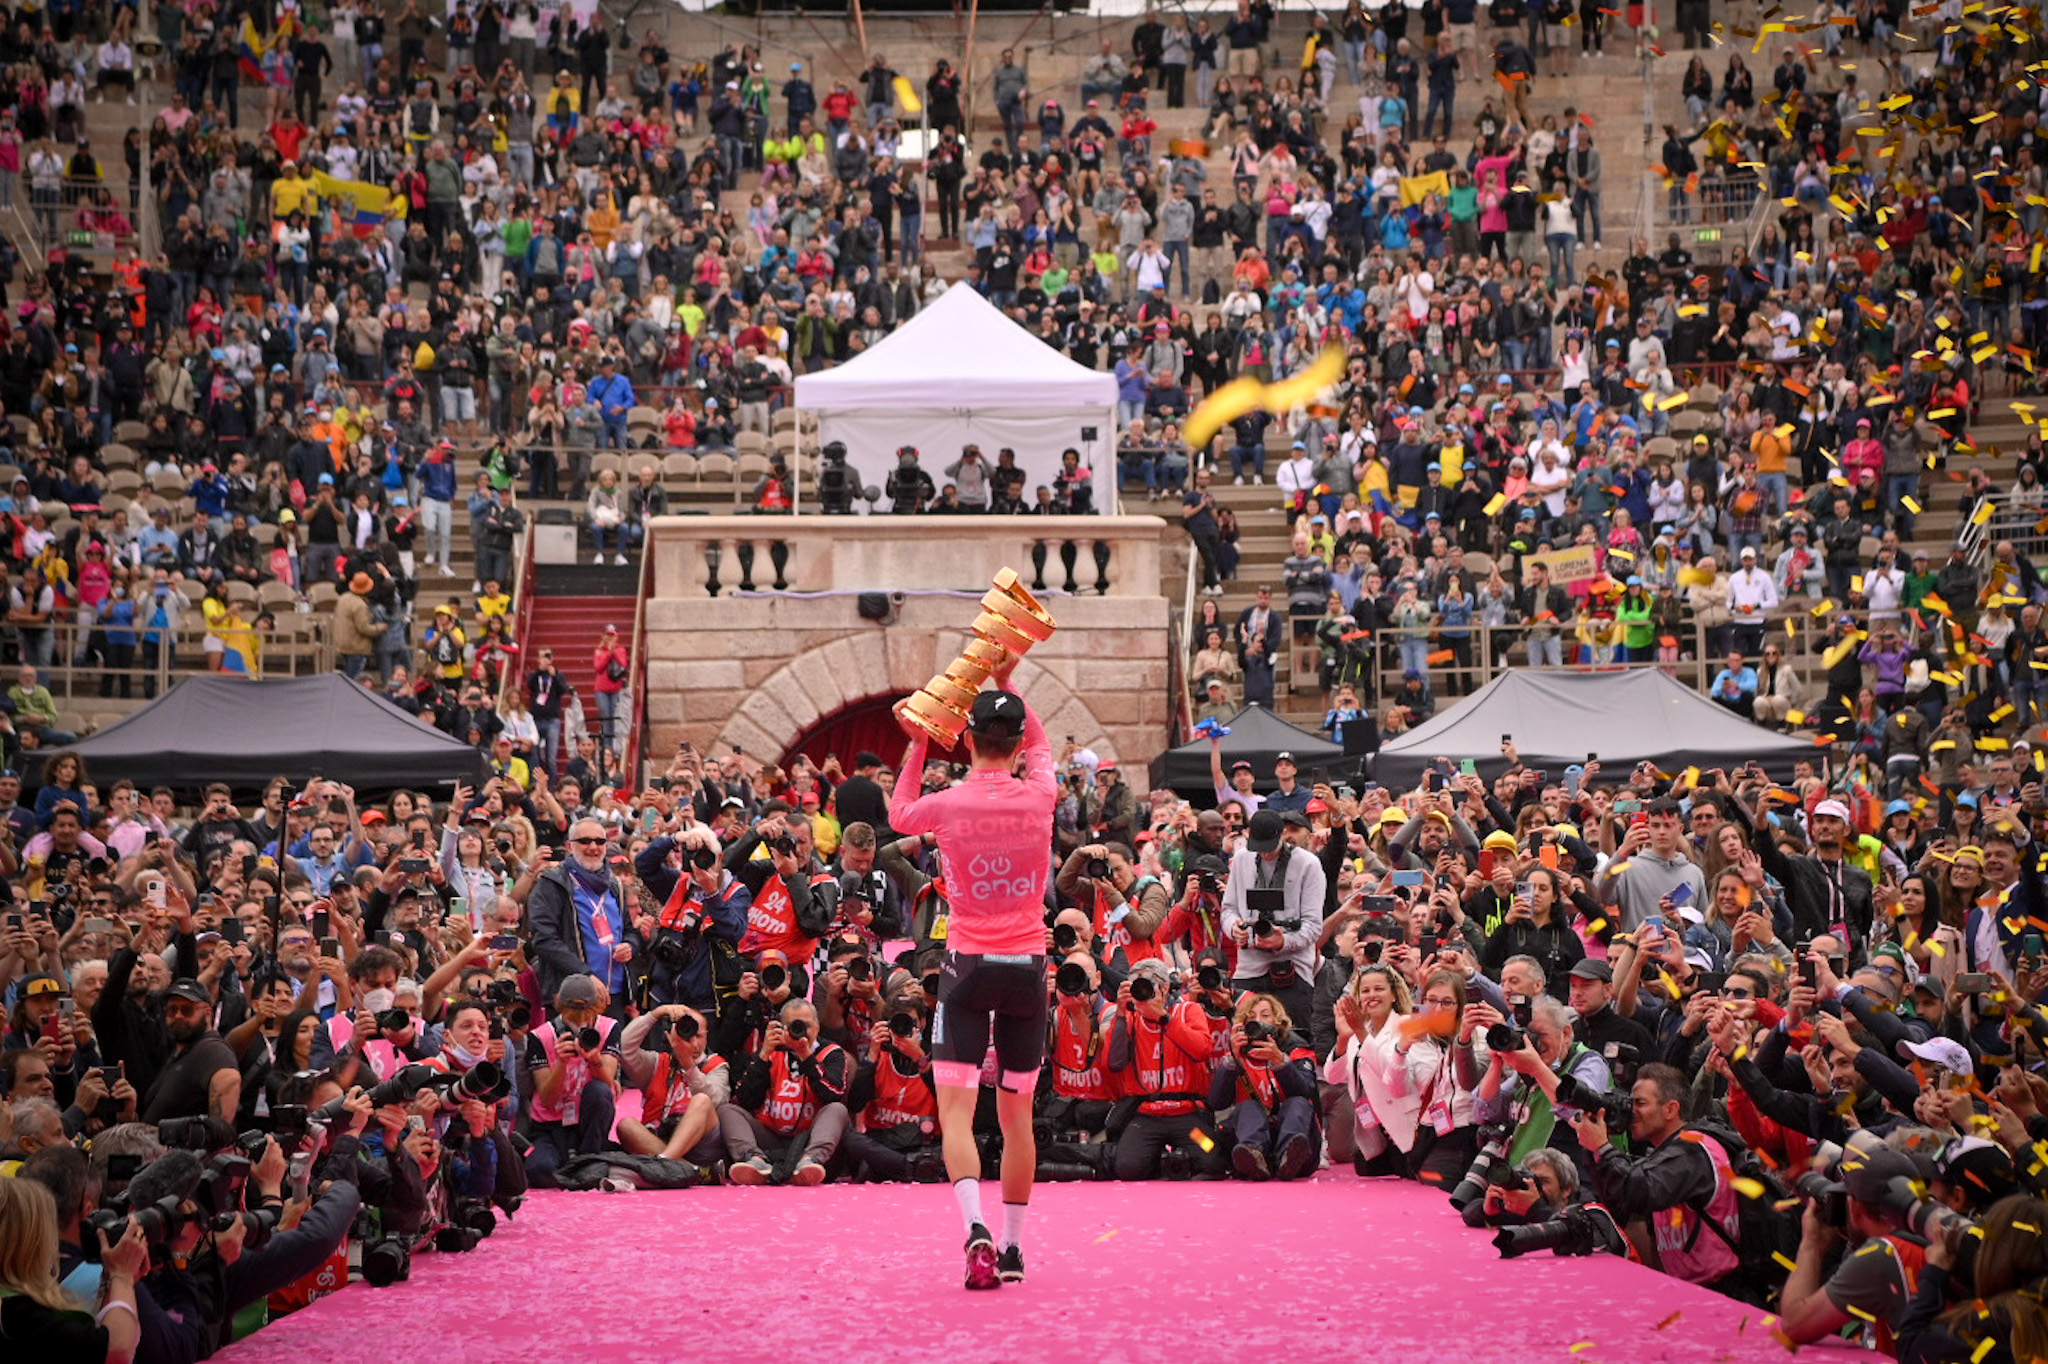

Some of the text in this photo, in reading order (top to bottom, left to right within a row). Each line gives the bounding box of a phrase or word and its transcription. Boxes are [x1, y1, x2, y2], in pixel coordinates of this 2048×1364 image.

[955, 811, 1043, 837] BORA
[971, 871, 1037, 900] enel
[763, 891, 788, 914] 24
[778, 1079, 801, 1098] 25
[1060, 1067, 1102, 1087] PHOTO
